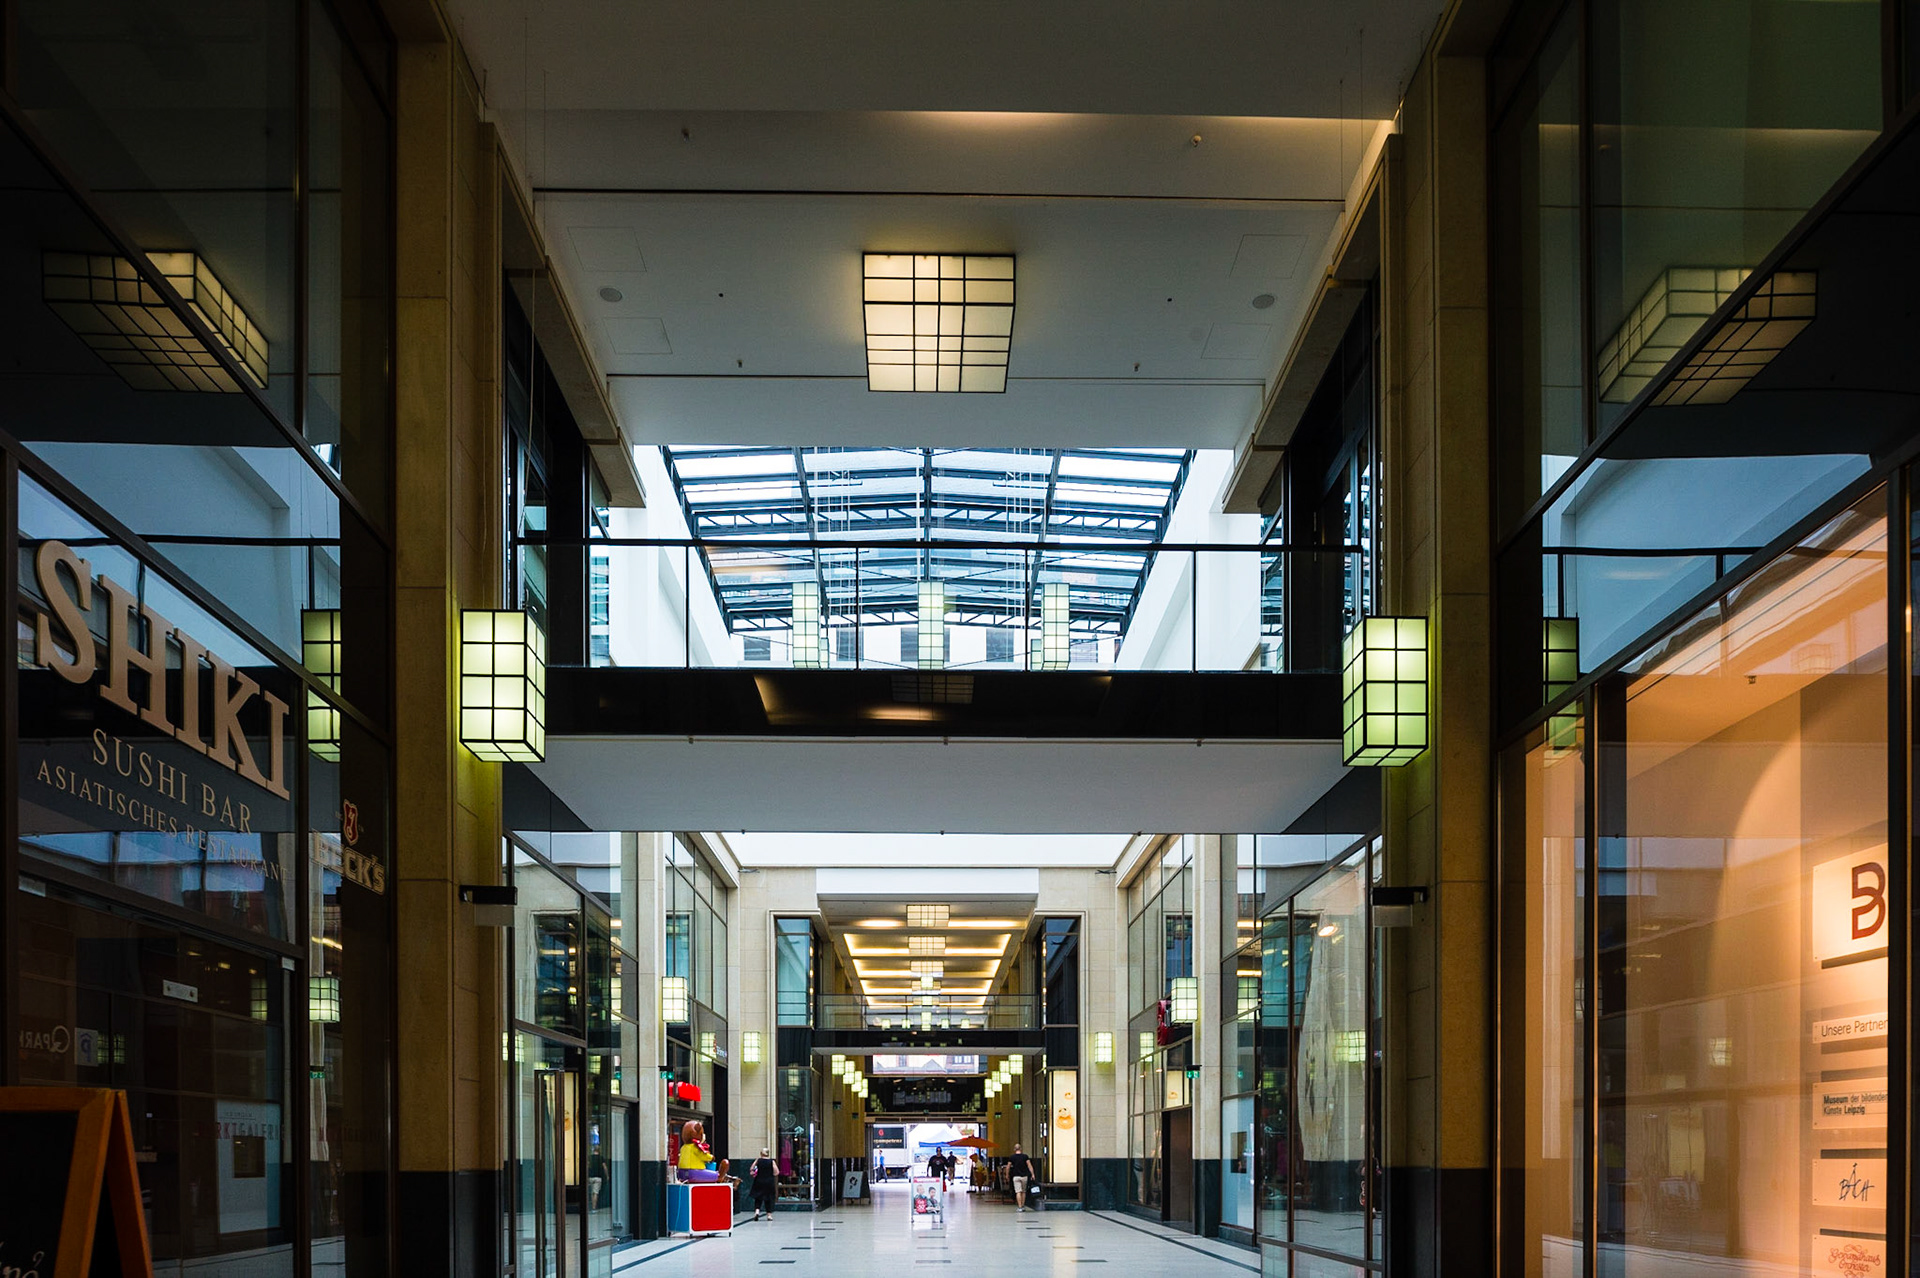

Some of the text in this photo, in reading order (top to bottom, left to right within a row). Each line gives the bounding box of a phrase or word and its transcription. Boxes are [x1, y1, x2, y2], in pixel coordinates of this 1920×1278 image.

[36, 540, 290, 800] SHIKI
[93, 728, 252, 835] SUSHI BAR
[37, 759, 287, 882] ASIATISCHES RESTAURANT
[1821, 1024, 1852, 1037] Unsere
[1823, 1095, 1849, 1104] Museum
[1850, 1095, 1860, 1103] der
[1844, 1104, 1866, 1115] Leipzig
